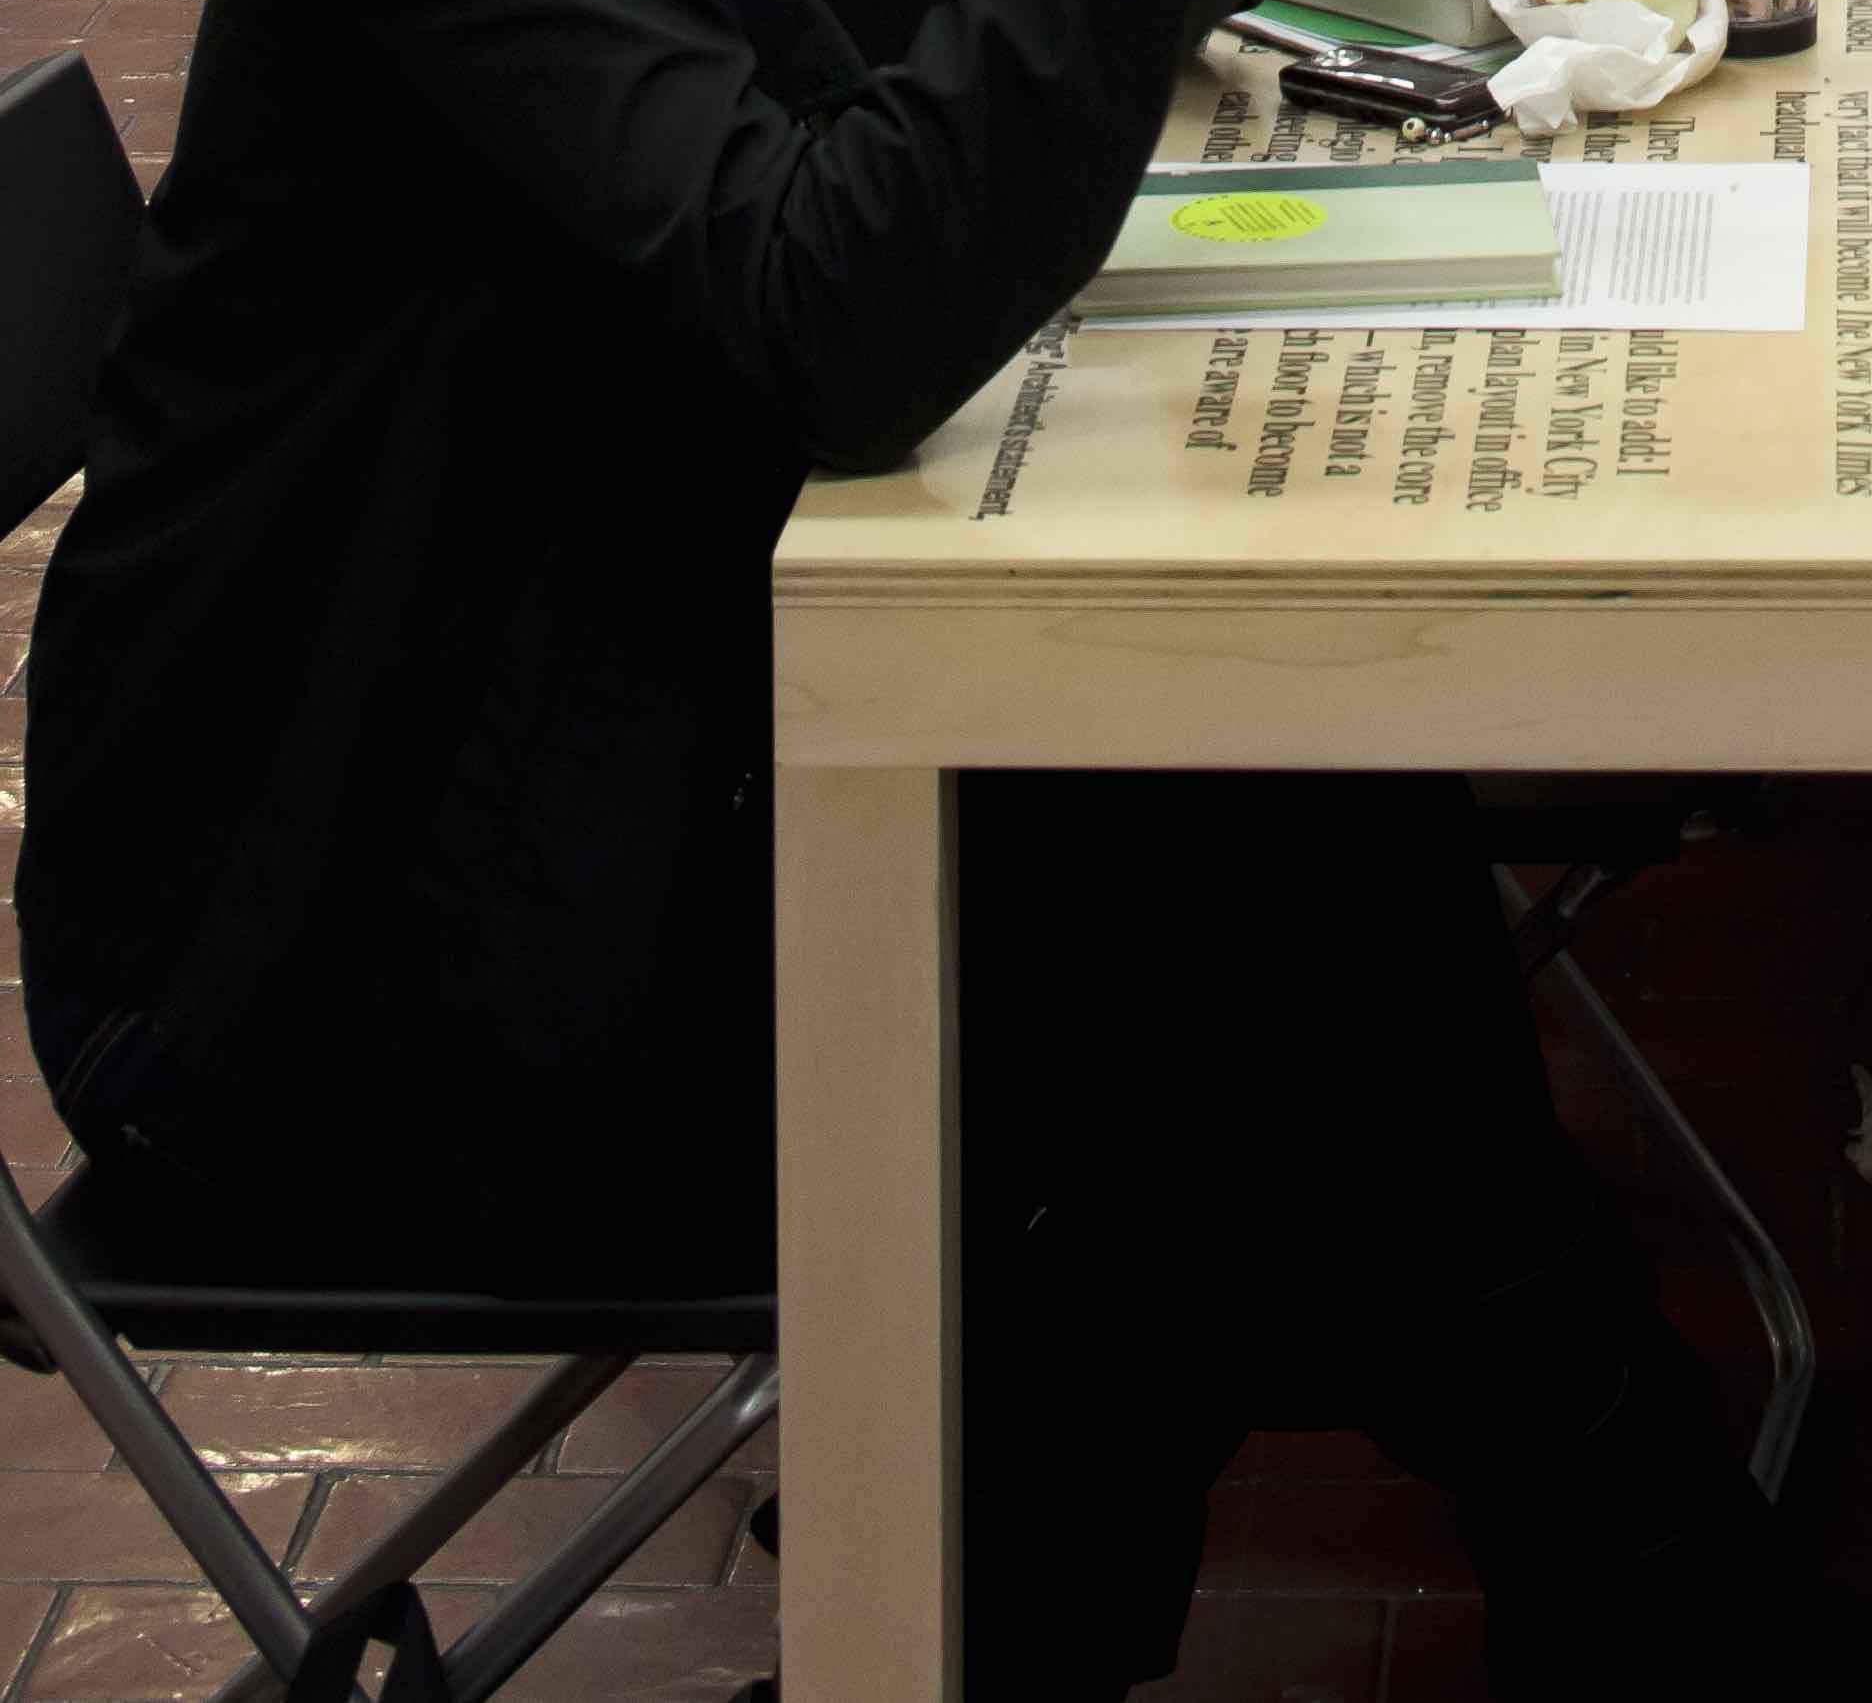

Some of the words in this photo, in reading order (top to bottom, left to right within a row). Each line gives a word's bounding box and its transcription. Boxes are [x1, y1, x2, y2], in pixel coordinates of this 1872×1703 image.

[1212, 90, 1266, 124] each
[1827, 91, 1869, 120] very
[1199, 127, 1255, 163] othe
[1250, 102, 1321, 162] eeting
[1582, 133, 1630, 163] ther
[1645, 116, 1694, 162] There
[1207, 337, 1249, 367] are
[1472, 329, 1542, 367] plan
[1557, 335, 1605, 353] in
[1627, 329, 1680, 357] uld
[1271, 352, 1328, 395] floor
[1339, 349, 1400, 405] which
[1406, 355, 1452, 423] remove
[1552, 357, 1606, 397] New
[1624, 362, 1677, 394] like
[1002, 361, 1068, 439] Architect's
[1191, 370, 1241, 427] aware
[1265, 399, 1315, 417] to
[1335, 408, 1385, 425] is
[1461, 371, 1536, 430] layout
[1622, 398, 1670, 417] to
[1184, 430, 1241, 451] of
[1328, 428, 1381, 459] not
[1400, 426, 1454, 457] the
[1473, 434, 1524, 453] in
[1545, 403, 1601, 451] York
[1618, 421, 1672, 462] add:
[1245, 421, 1314, 497] become
[1325, 464, 1363, 477] a
[1616, 468, 1668, 477] I
[967, 439, 1037, 521] statement,
[1391, 461, 1435, 505] core
[1463, 457, 1525, 512] office
[1523, 457, 1595, 499] City
